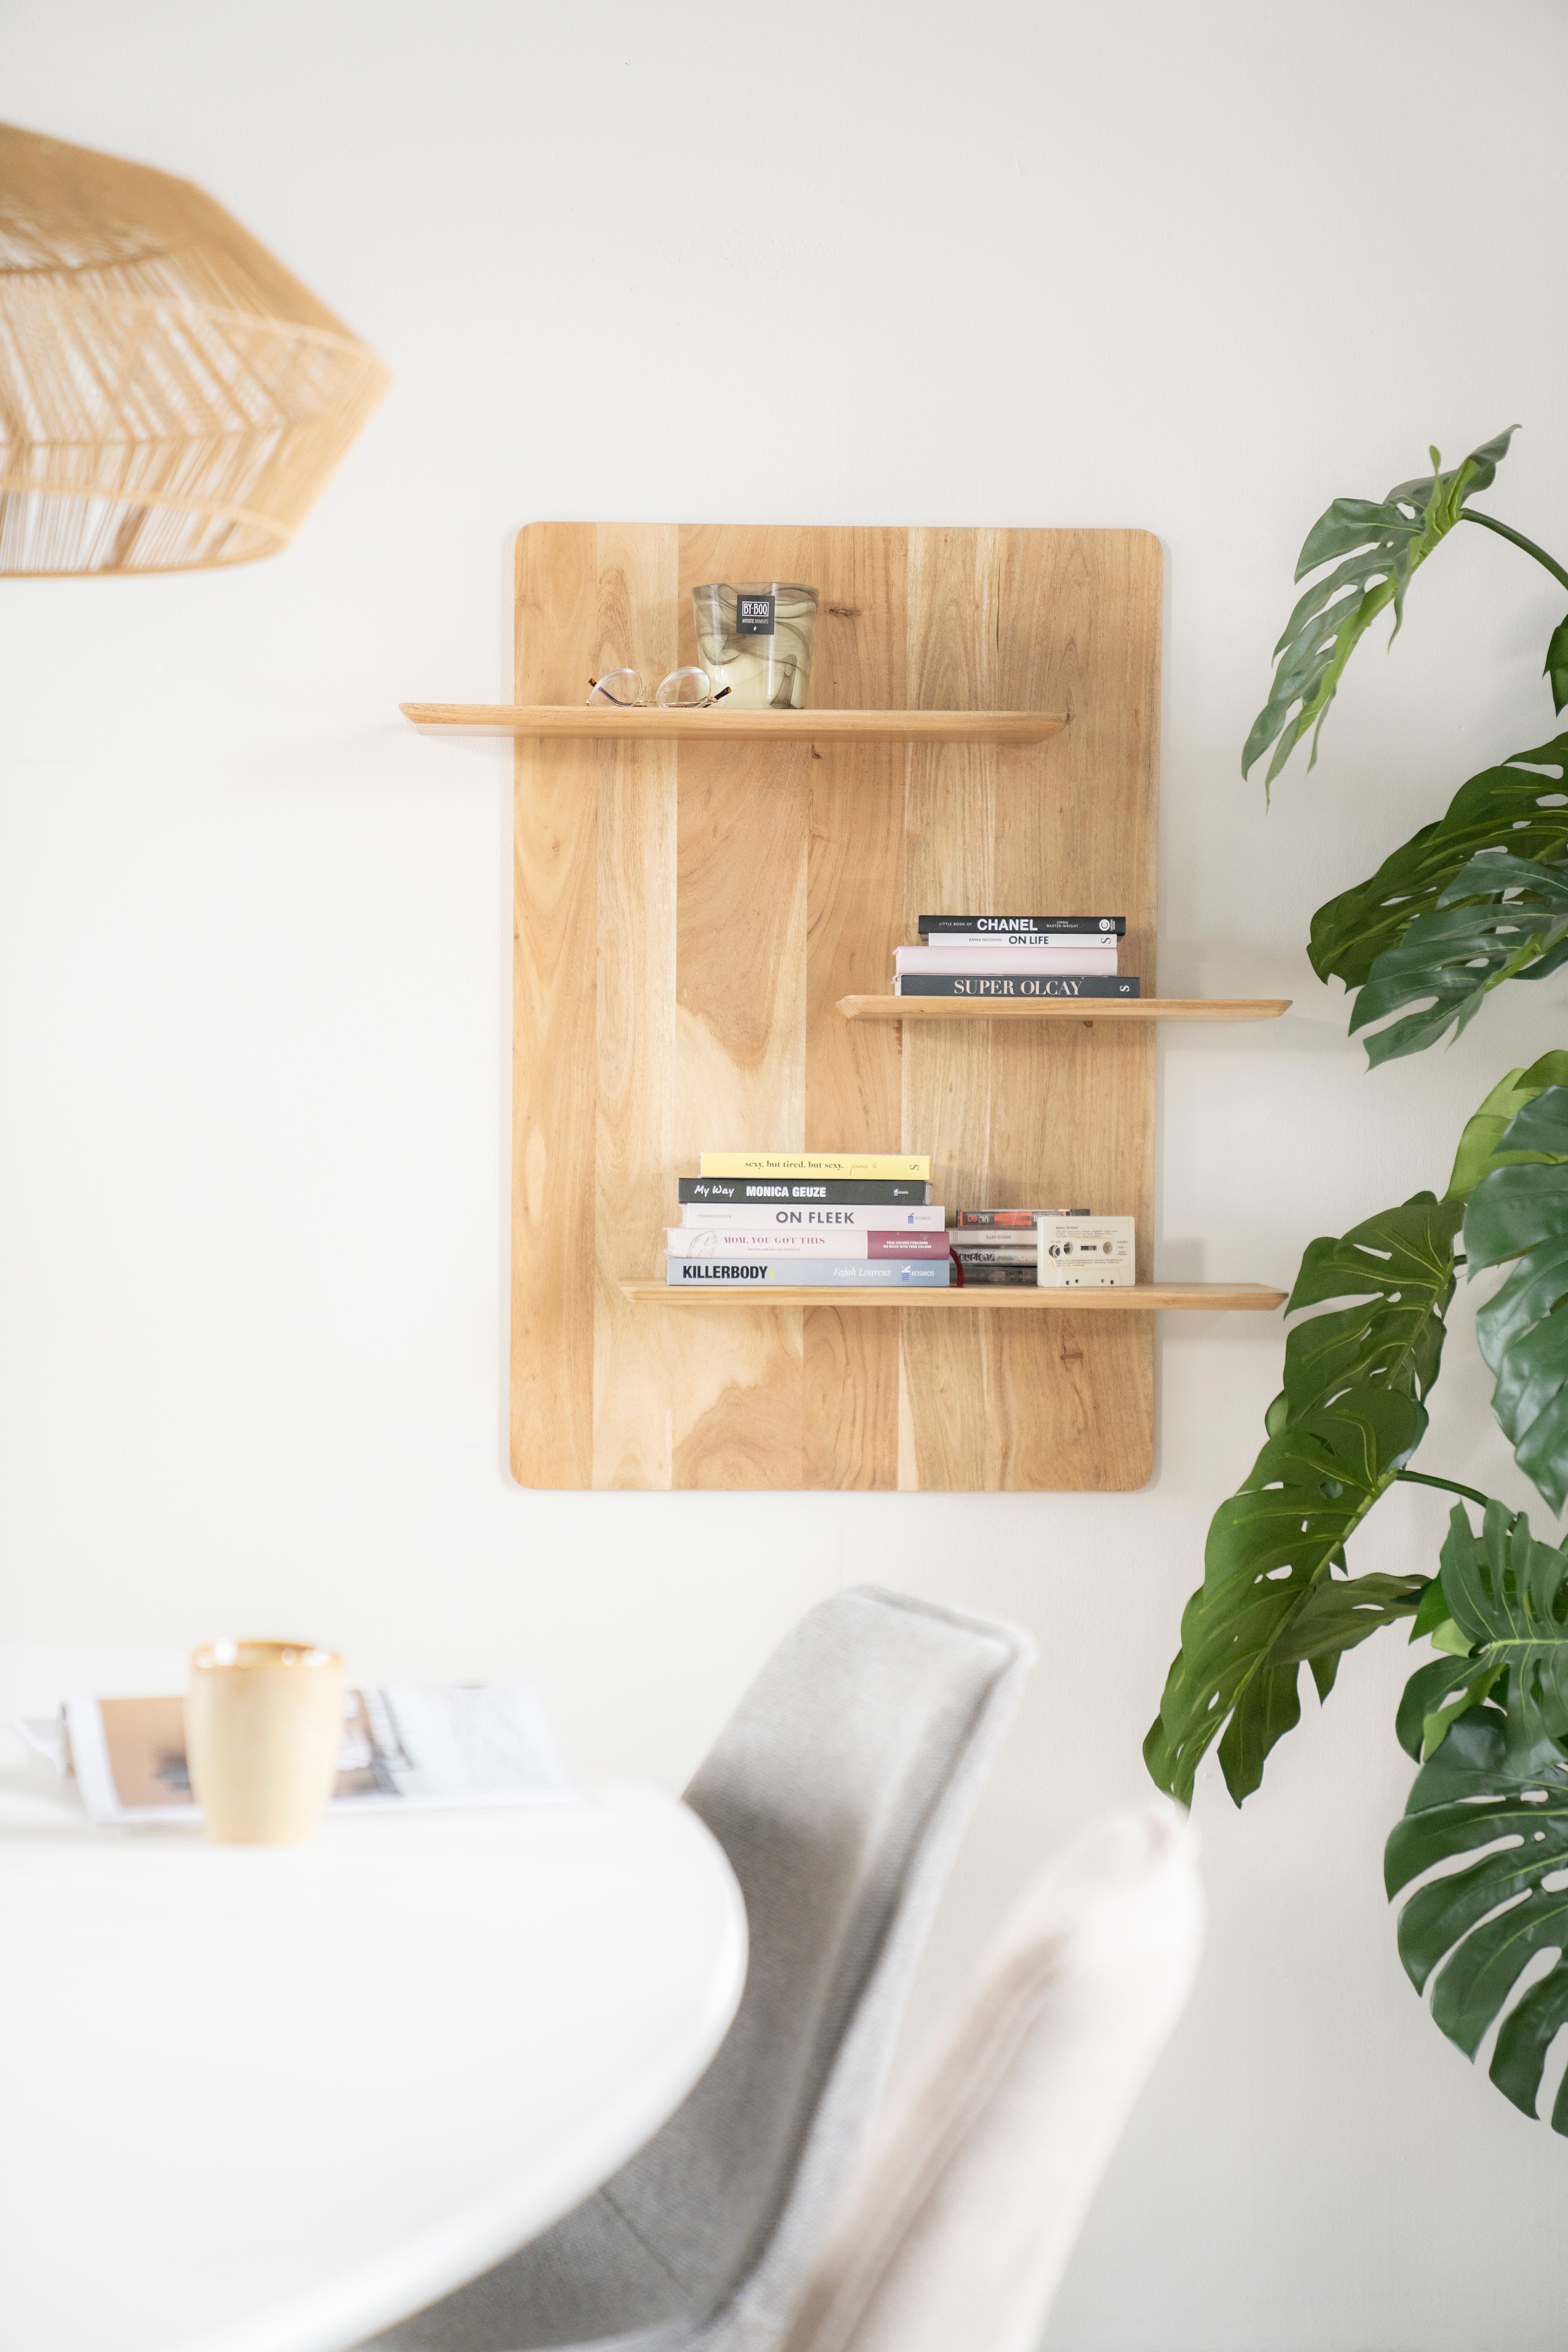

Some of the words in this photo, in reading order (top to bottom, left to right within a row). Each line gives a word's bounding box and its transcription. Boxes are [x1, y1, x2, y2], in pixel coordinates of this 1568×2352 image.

[744, 603, 767, 615] BY-BOO
[977, 919, 1038, 931] CHANEL
[1009, 936, 1027, 944] ON
[1030, 936, 1049, 944] LIFE
[954, 980, 1015, 995] SUPER
[1021, 981, 1083, 995] OLCAY
[849, 1163, 869, 1176] jamie
[694, 1185, 710, 1198] My
[712, 1185, 734, 1198] Way
[746, 1186, 789, 1197] MONICA
[792, 1187, 826, 1197] GEUZE
[776, 1211, 802, 1223] ON
[809, 1212, 855, 1224] FLEEK
[956, 1251, 995, 1261] ourtone
[683, 1265, 768, 1279] KILLERBODY
[834, 1268, 857, 1278] Fajah
[858, 1269, 891, 1277] Lourens
